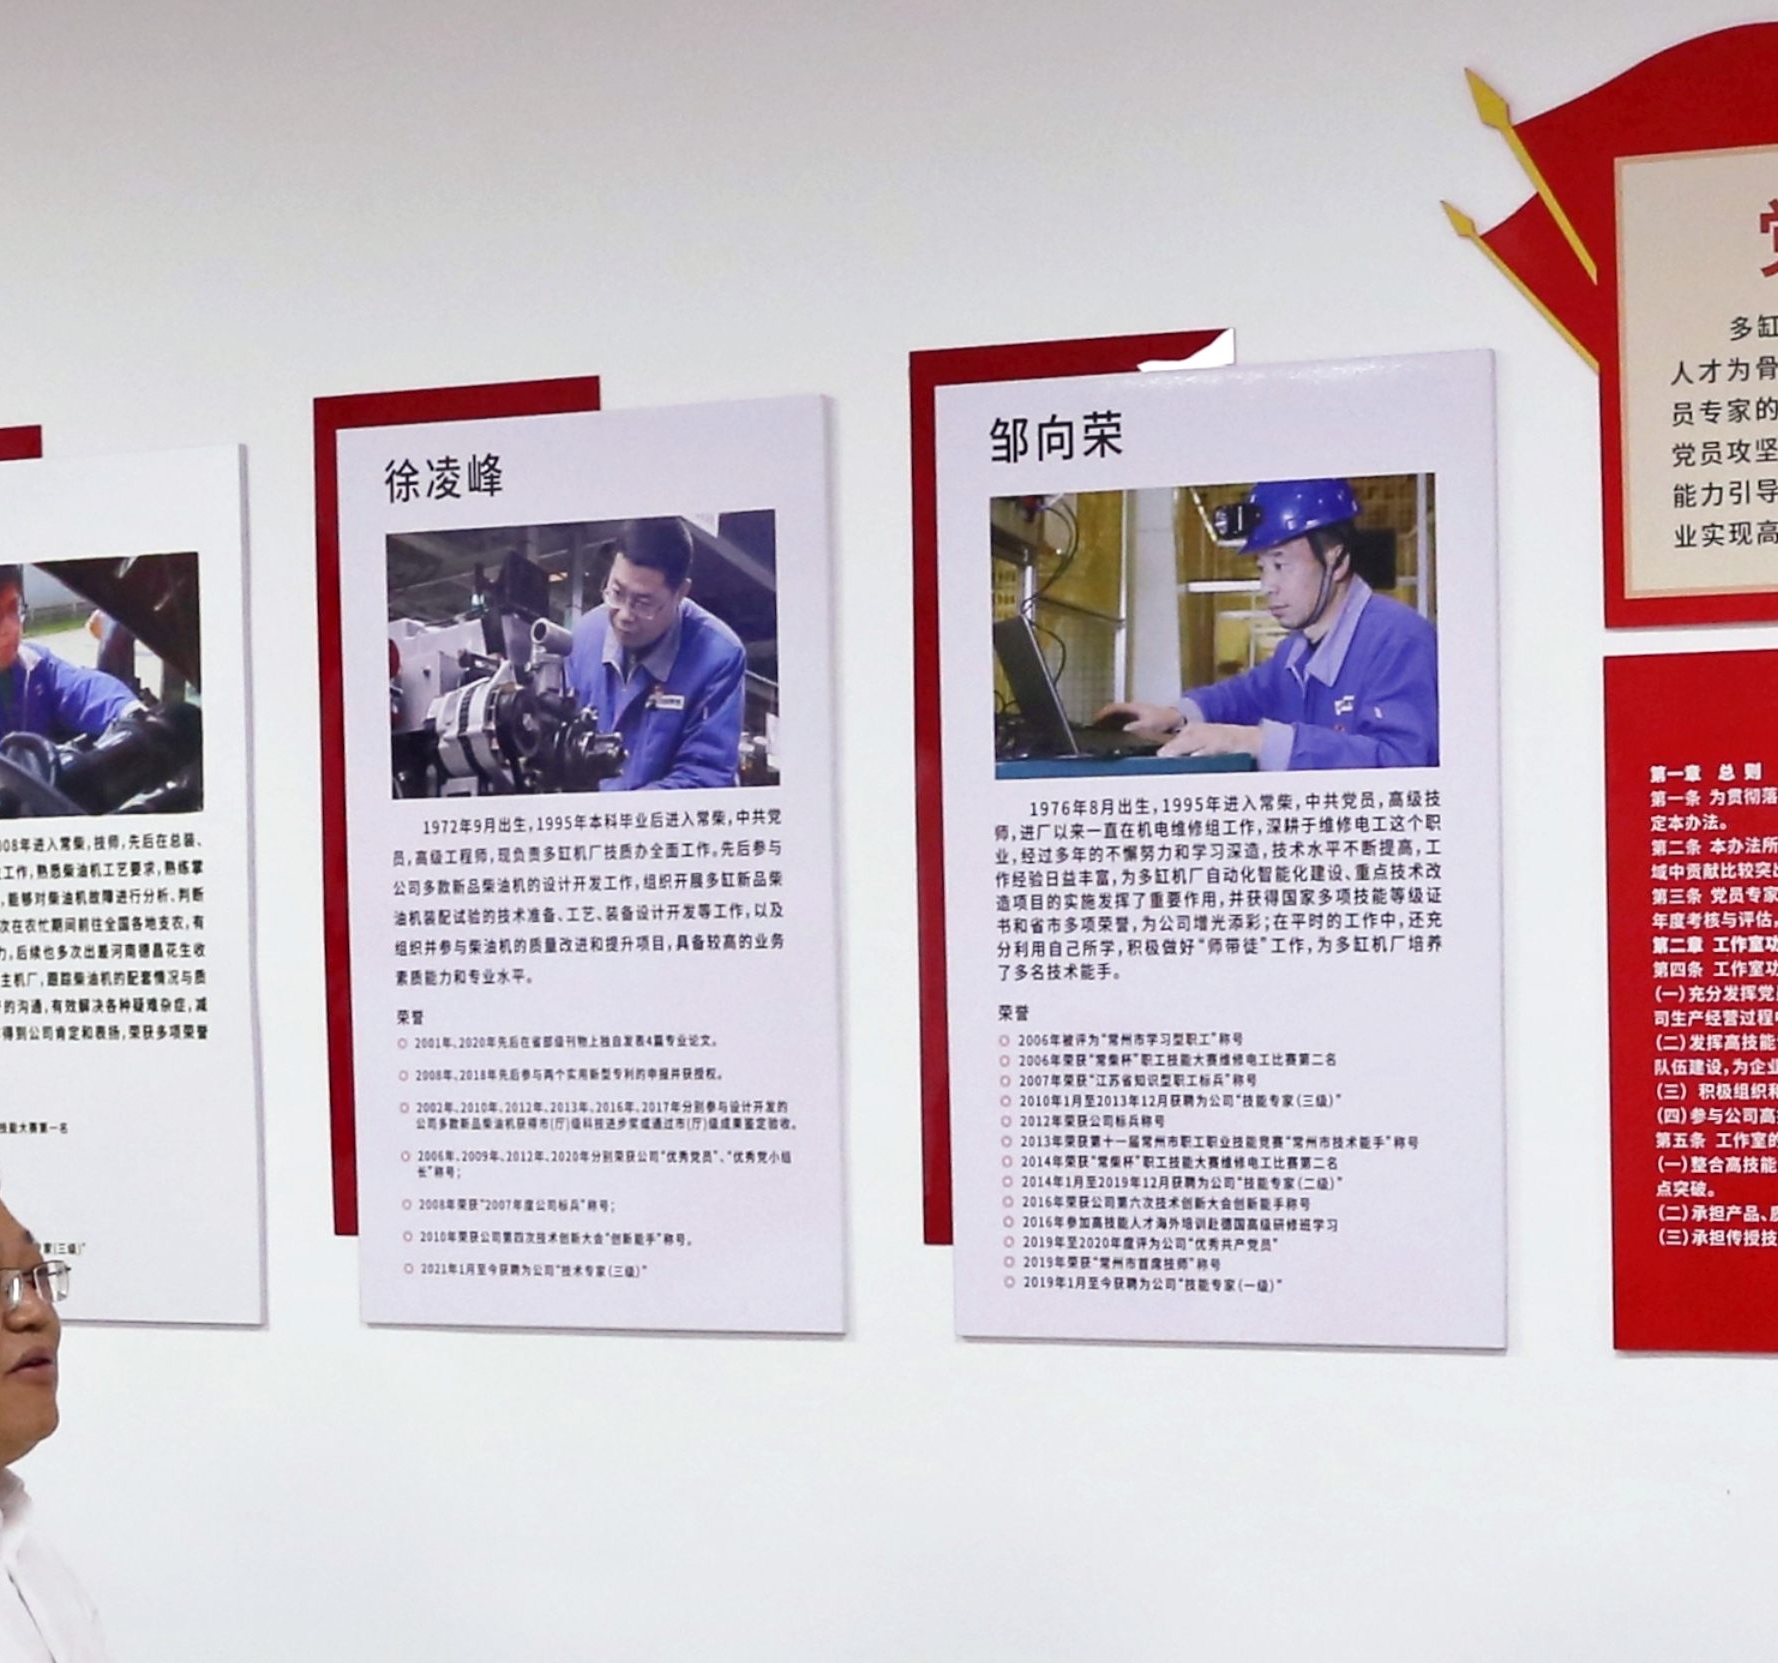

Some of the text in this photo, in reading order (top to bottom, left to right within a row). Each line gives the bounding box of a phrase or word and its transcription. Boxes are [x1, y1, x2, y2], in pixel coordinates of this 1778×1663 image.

[989, 411, 1124, 464] 邹向荣
[385, 453, 504, 503] 徐凌峰
[1650, 764, 1701, 783] 第一章
[1650, 789, 1702, 807] 第一条
[1651, 813, 1727, 832] 定本办法。
[1651, 838, 1702, 856] 第二条
[1652, 887, 1702, 905] 第三条
[1653, 936, 1703, 954] 第二章
[396, 968, 532, 986] 素质能力和专业水平。
[998, 963, 1119, 981] 了多名技术能手。
[1653, 961, 1703, 978] 第四条
[397, 1010, 423, 1025] 荣誉
[999, 1005, 1029, 1021] 荣誉
[1021, 1114, 1164, 1128] 2012年荣获公司标兵称号
[1655, 1132, 1706, 1149] 第五条
[1656, 1180, 1714, 1197] 点突破。
